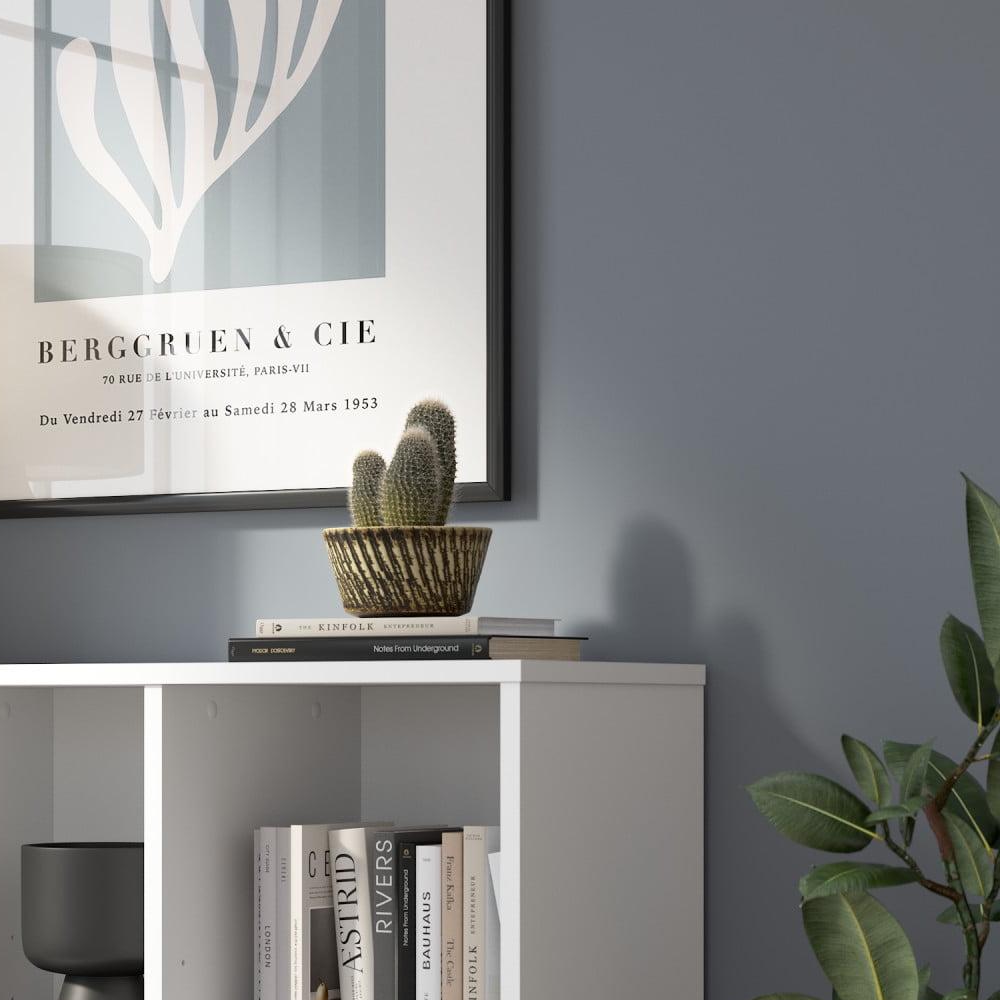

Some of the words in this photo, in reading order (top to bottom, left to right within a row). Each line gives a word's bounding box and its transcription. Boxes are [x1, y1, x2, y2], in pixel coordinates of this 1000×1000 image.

[37, 327, 253, 364] BERGGRUEN
[273, 324, 293, 349] &
[313, 319, 376, 347] CIE
[102, 375, 115, 384] 70
[119, 373, 142, 384] RUE
[146, 372, 161, 382] DE
[254, 363, 310, 376] PARIS-VII
[39, 414, 57, 426] Du
[63, 411, 122, 424] Vendredi
[128, 409, 144, 421] 27
[150, 406, 198, 420] Février
[203, 408, 219, 418] au
[224, 402, 275, 416] Samedi
[281, 401, 297, 413] 28
[303, 400, 338, 412] Mars
[344, 397, 378, 410] 1953
[318, 623, 374, 631] KINFOLK
[373, 645, 393, 653] Notes
[446, 856, 455, 881] Franz
[375, 839, 393, 934] RIVERS
[446, 884, 455, 911] Kafka
[422, 891, 431, 970] BAUHAUS
